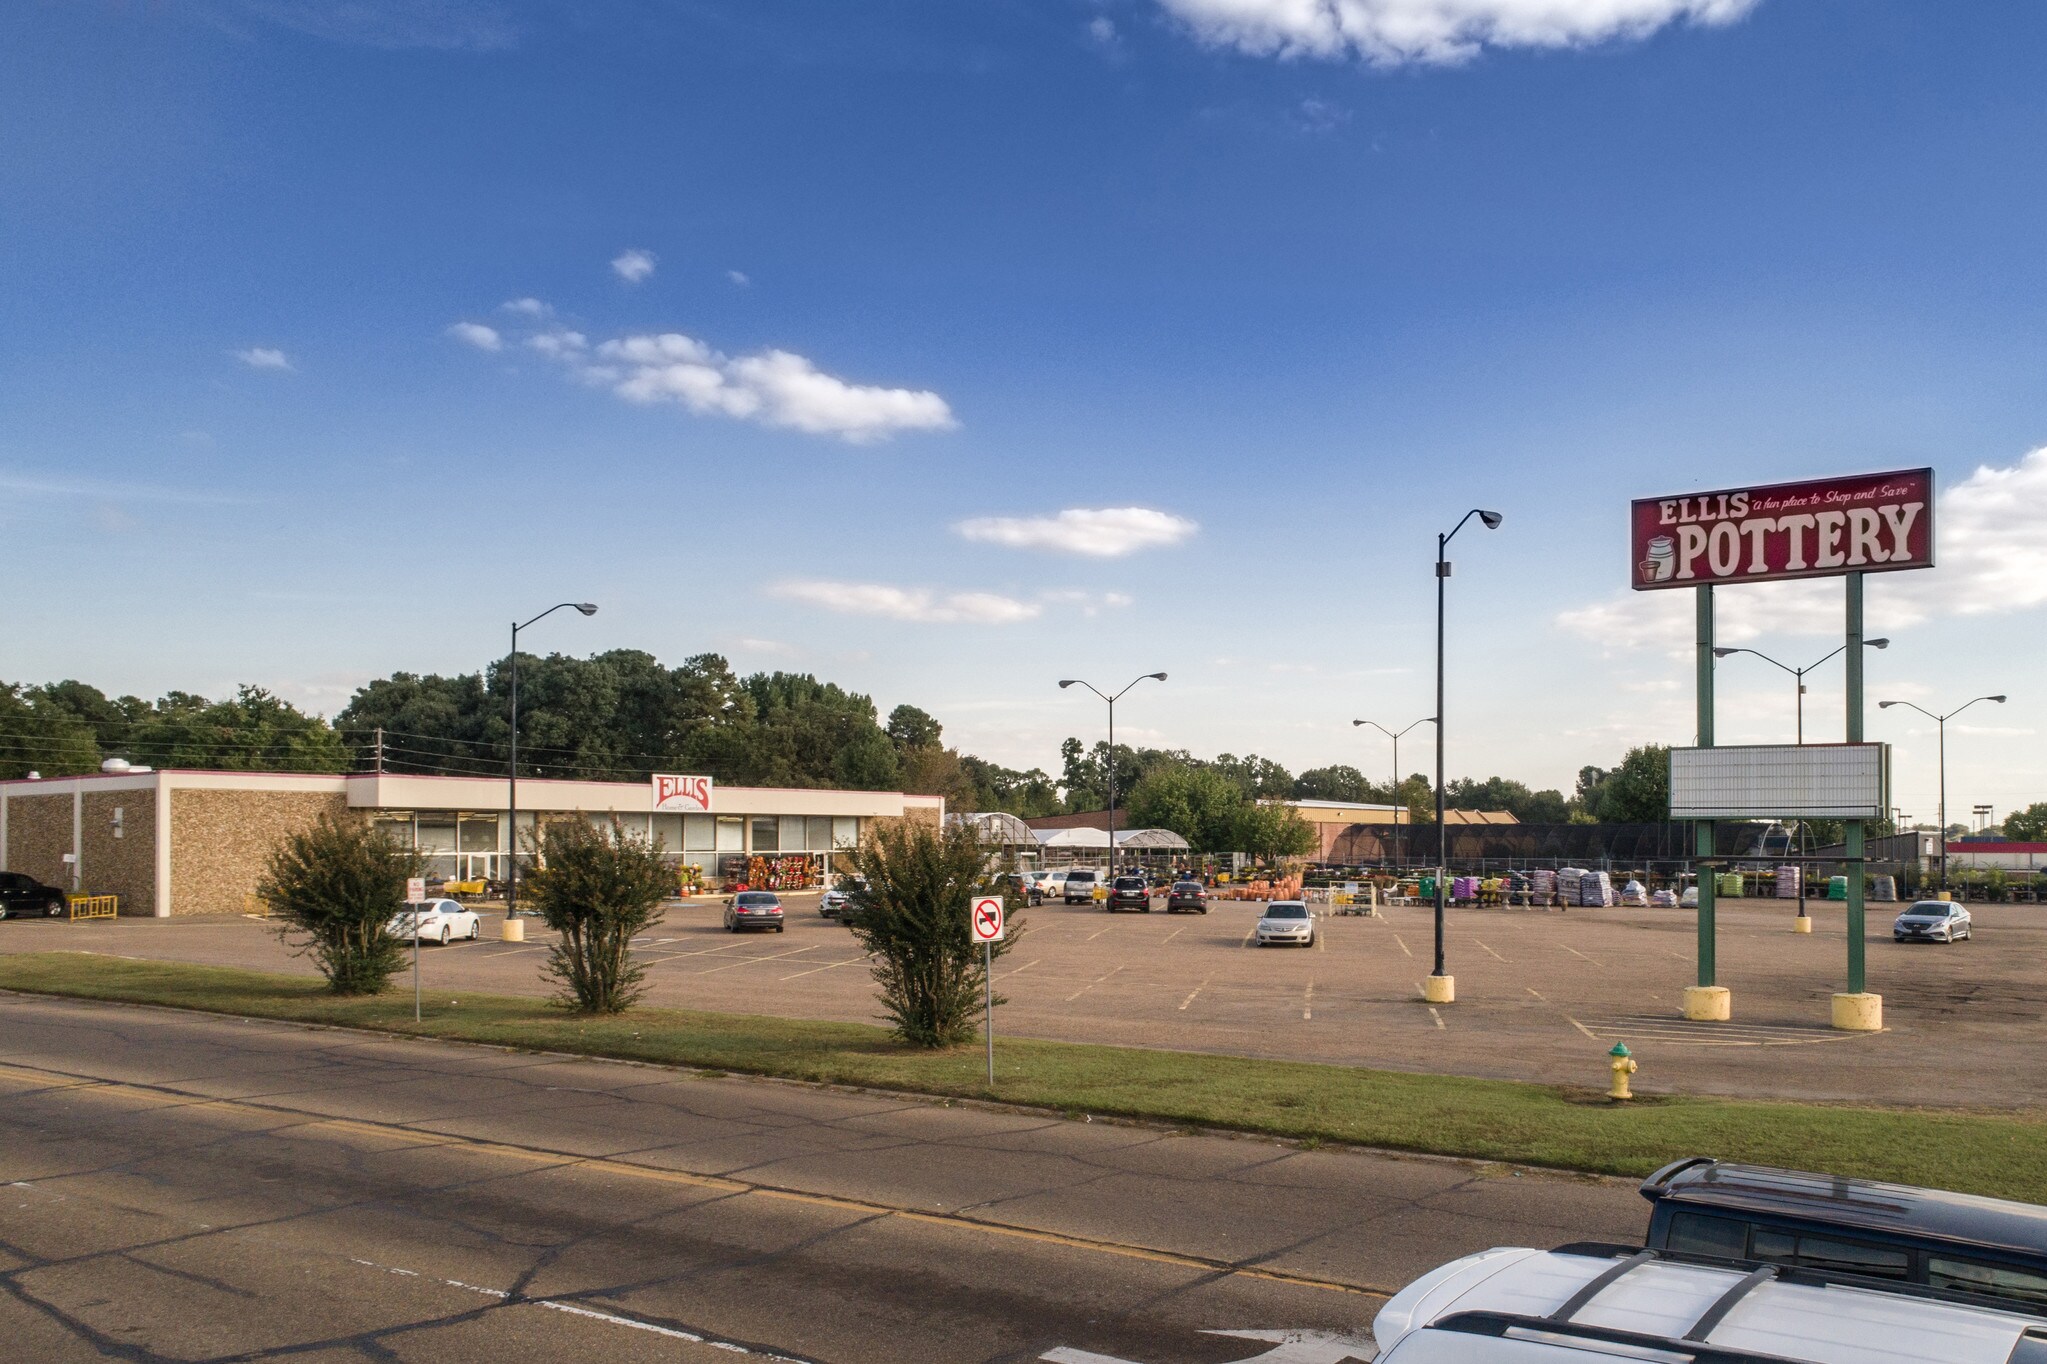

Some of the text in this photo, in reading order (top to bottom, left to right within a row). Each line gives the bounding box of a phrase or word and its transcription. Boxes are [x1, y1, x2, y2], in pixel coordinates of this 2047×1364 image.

[1659, 492, 1749, 525] ELLIS
[1763, 497, 1780, 511] fun
[1780, 495, 1808, 511] place
[1810, 493, 1821, 505] to
[1823, 490, 1851, 506] Shop
[1854, 487, 1877, 500] and
[1676, 502, 1924, 580] POTTERY
[656, 776, 709, 811] ELLIS
